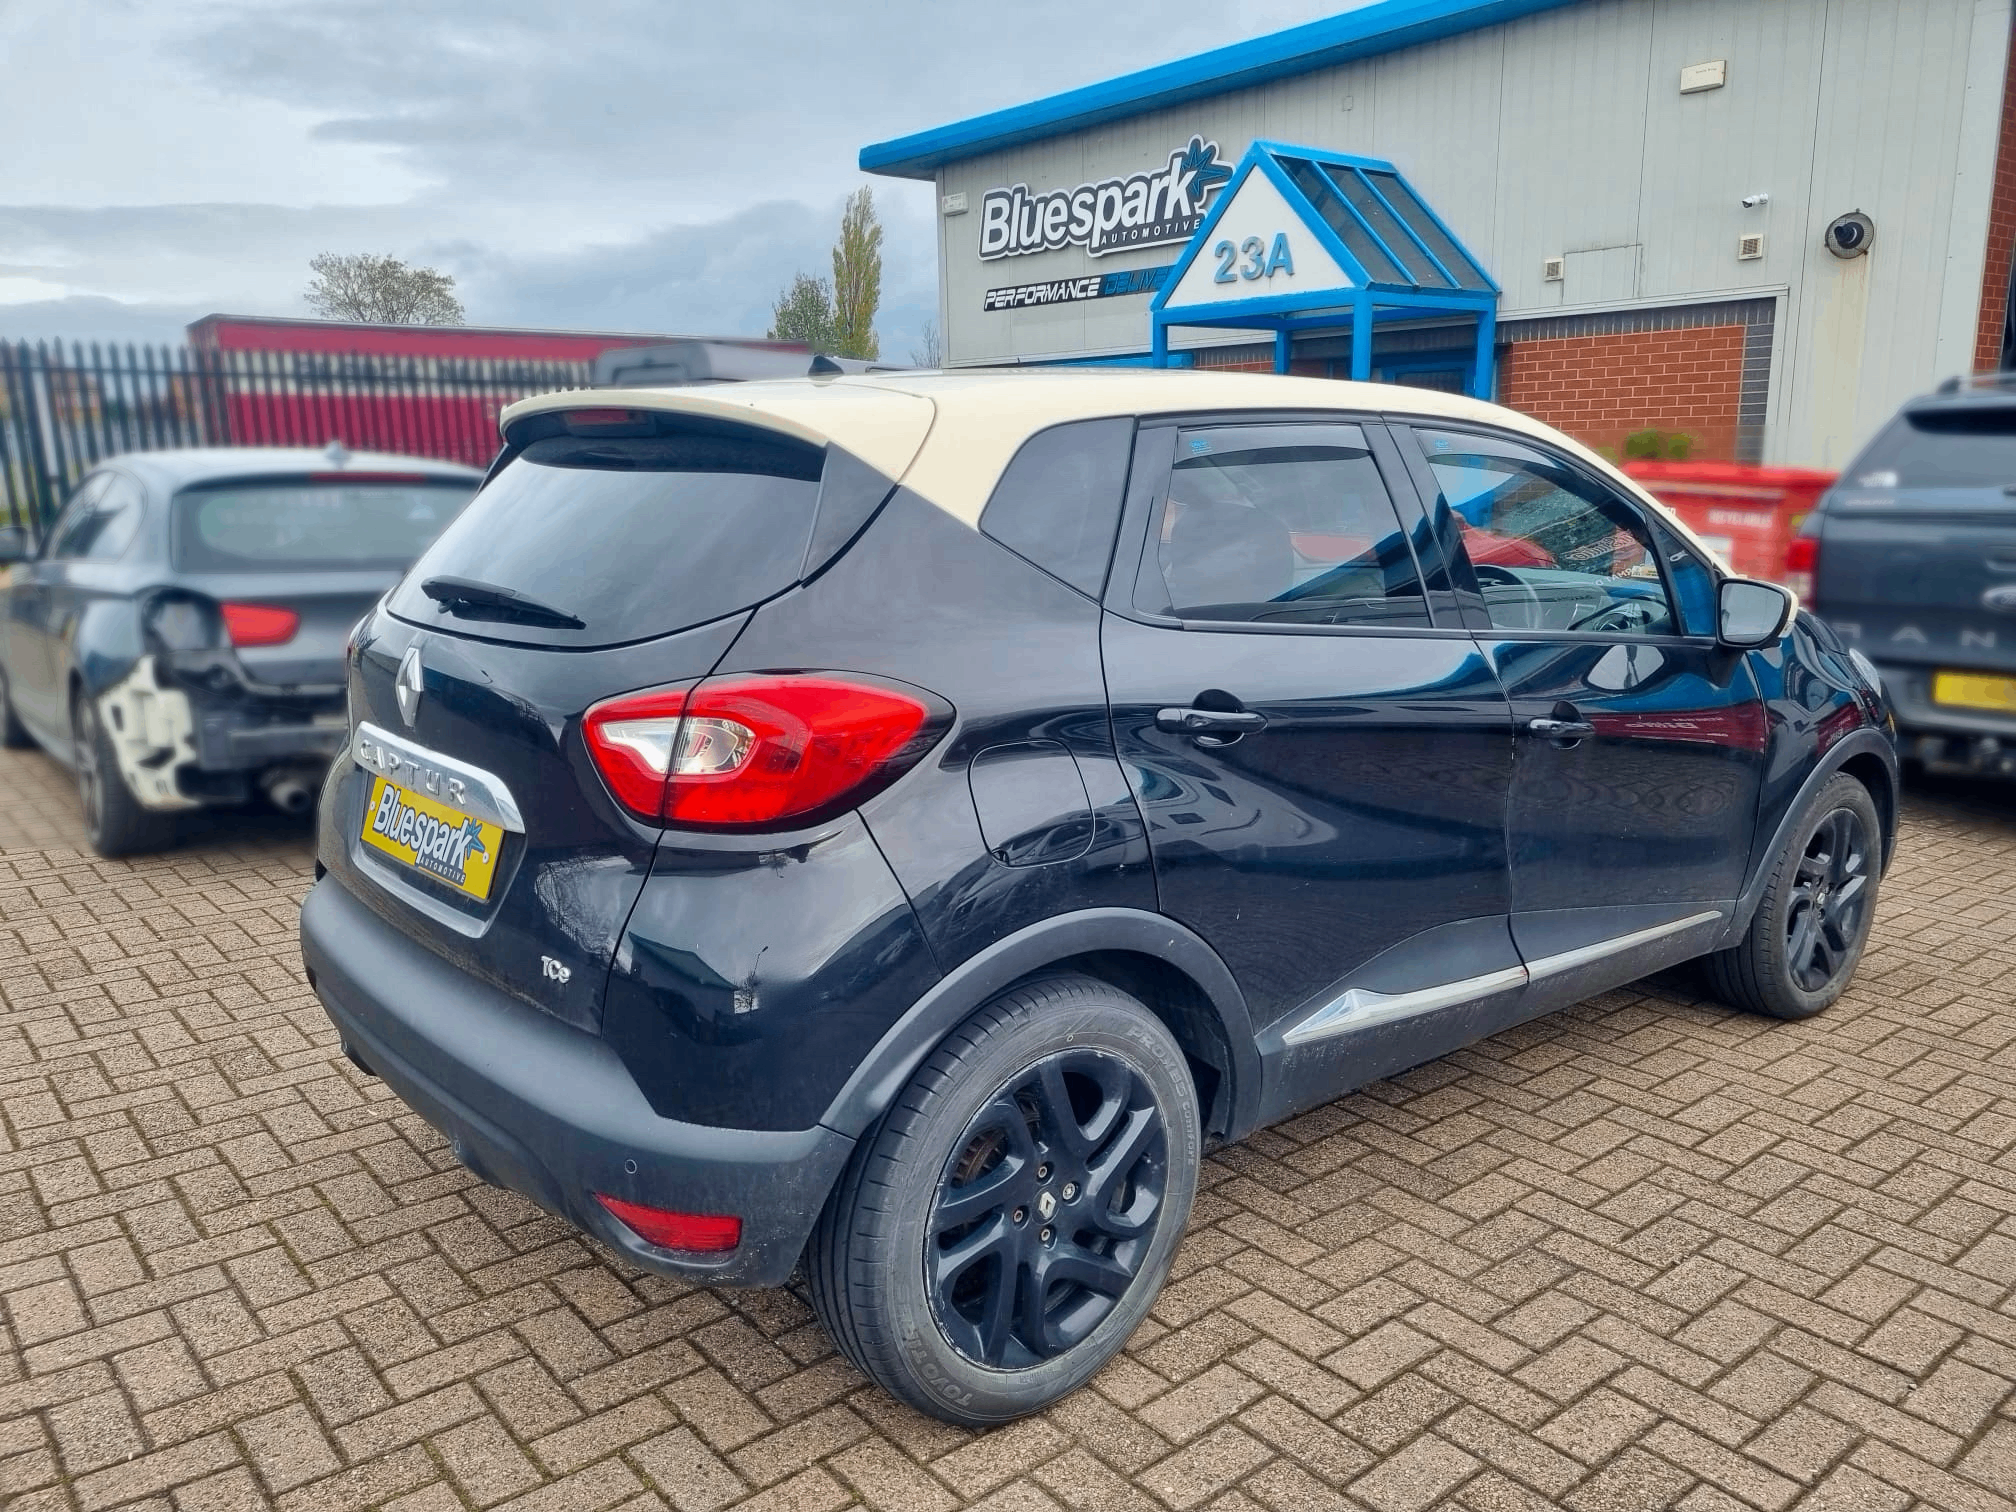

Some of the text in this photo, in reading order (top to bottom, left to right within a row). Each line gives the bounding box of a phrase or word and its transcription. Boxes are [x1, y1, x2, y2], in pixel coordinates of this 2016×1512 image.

[981, 156, 1198, 254] Bluespark
[1100, 218, 1201, 246] AUTOMOTIVE
[1213, 232, 1296, 284] 23A
[984, 277, 1102, 310] PERFORMANCE
[360, 739, 467, 805] CAPTUR
[373, 784, 473, 870] Bluespark
[419, 855, 466, 884] AUTOMOTIVE
[540, 955, 572, 984] TCe
[920, 1362, 974, 1407] TOYO
